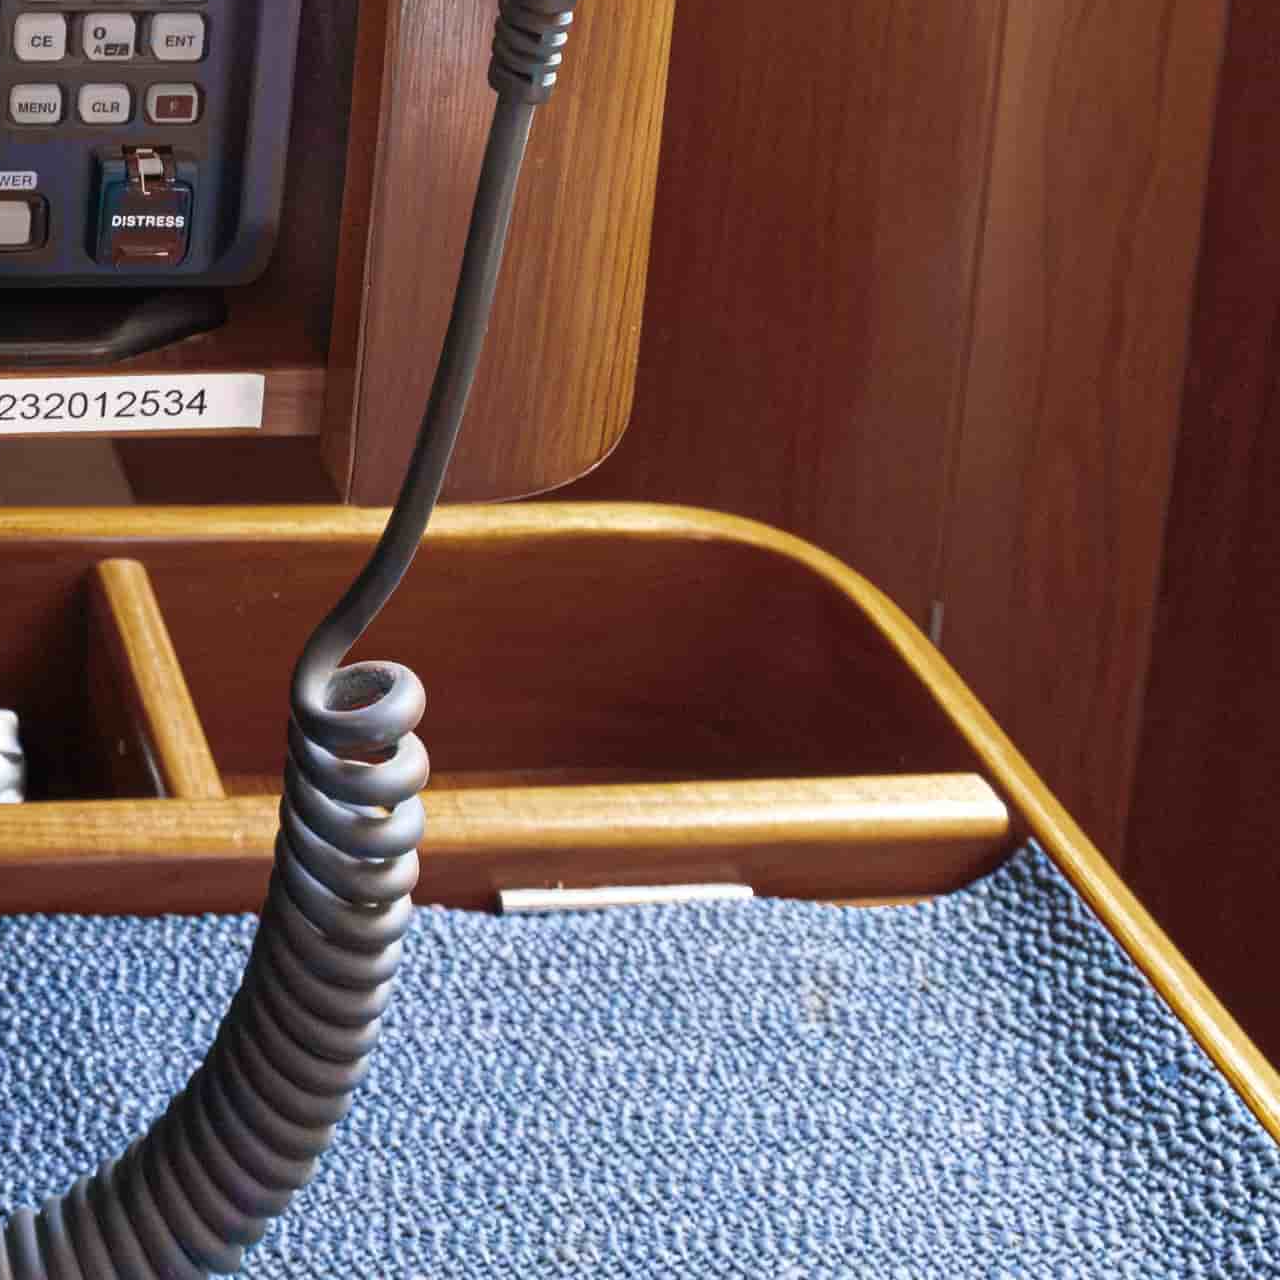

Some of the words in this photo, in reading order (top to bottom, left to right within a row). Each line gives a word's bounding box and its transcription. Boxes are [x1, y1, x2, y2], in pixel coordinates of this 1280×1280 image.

[30, 35, 53, 48] CE
[165, 35, 196, 47] ENT
[17, 101, 57, 114] MENU
[92, 101, 120, 114] CLR
[111, 215, 185, 228] DISTRESS
